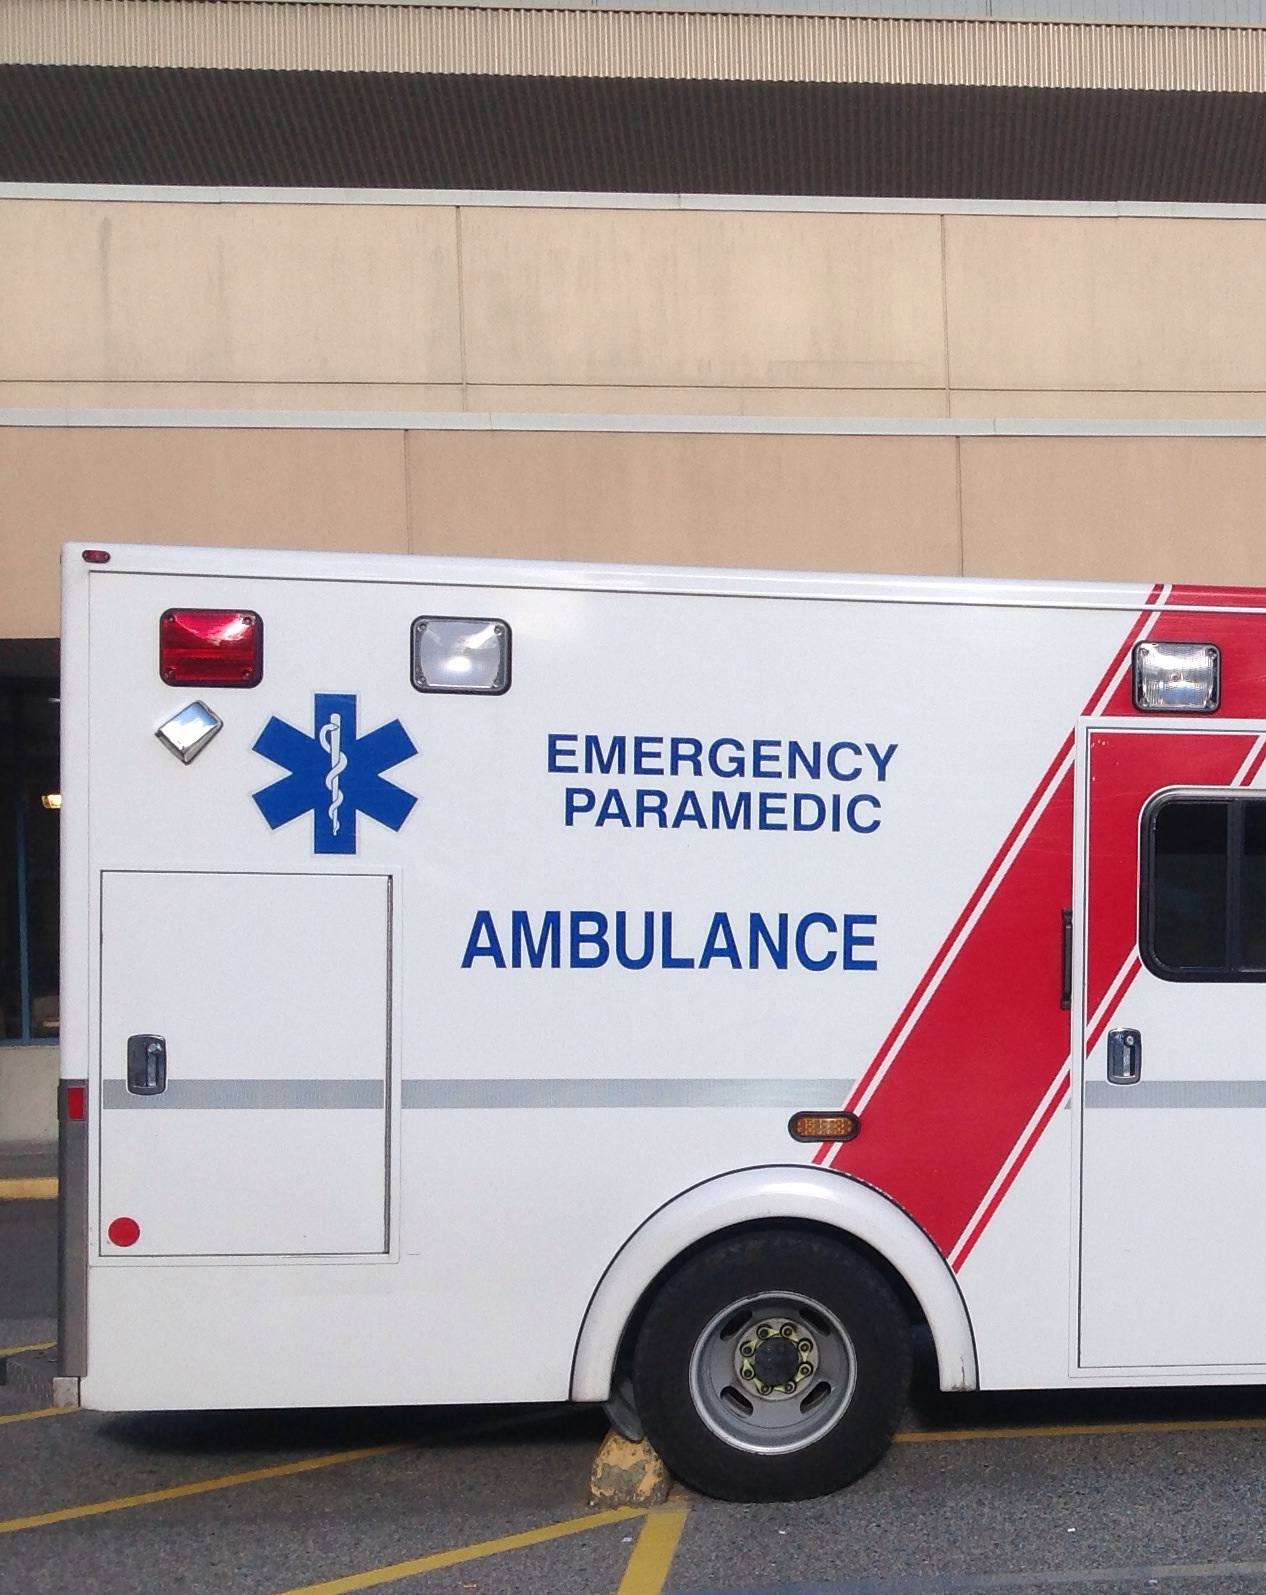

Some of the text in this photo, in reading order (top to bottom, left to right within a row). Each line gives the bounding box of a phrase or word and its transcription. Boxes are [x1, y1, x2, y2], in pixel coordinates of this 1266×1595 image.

[547, 733, 898, 782] EMERGENCY
[564, 787, 882, 834] PARAMEDIC
[461, 910, 877, 971] AMBULANCE
